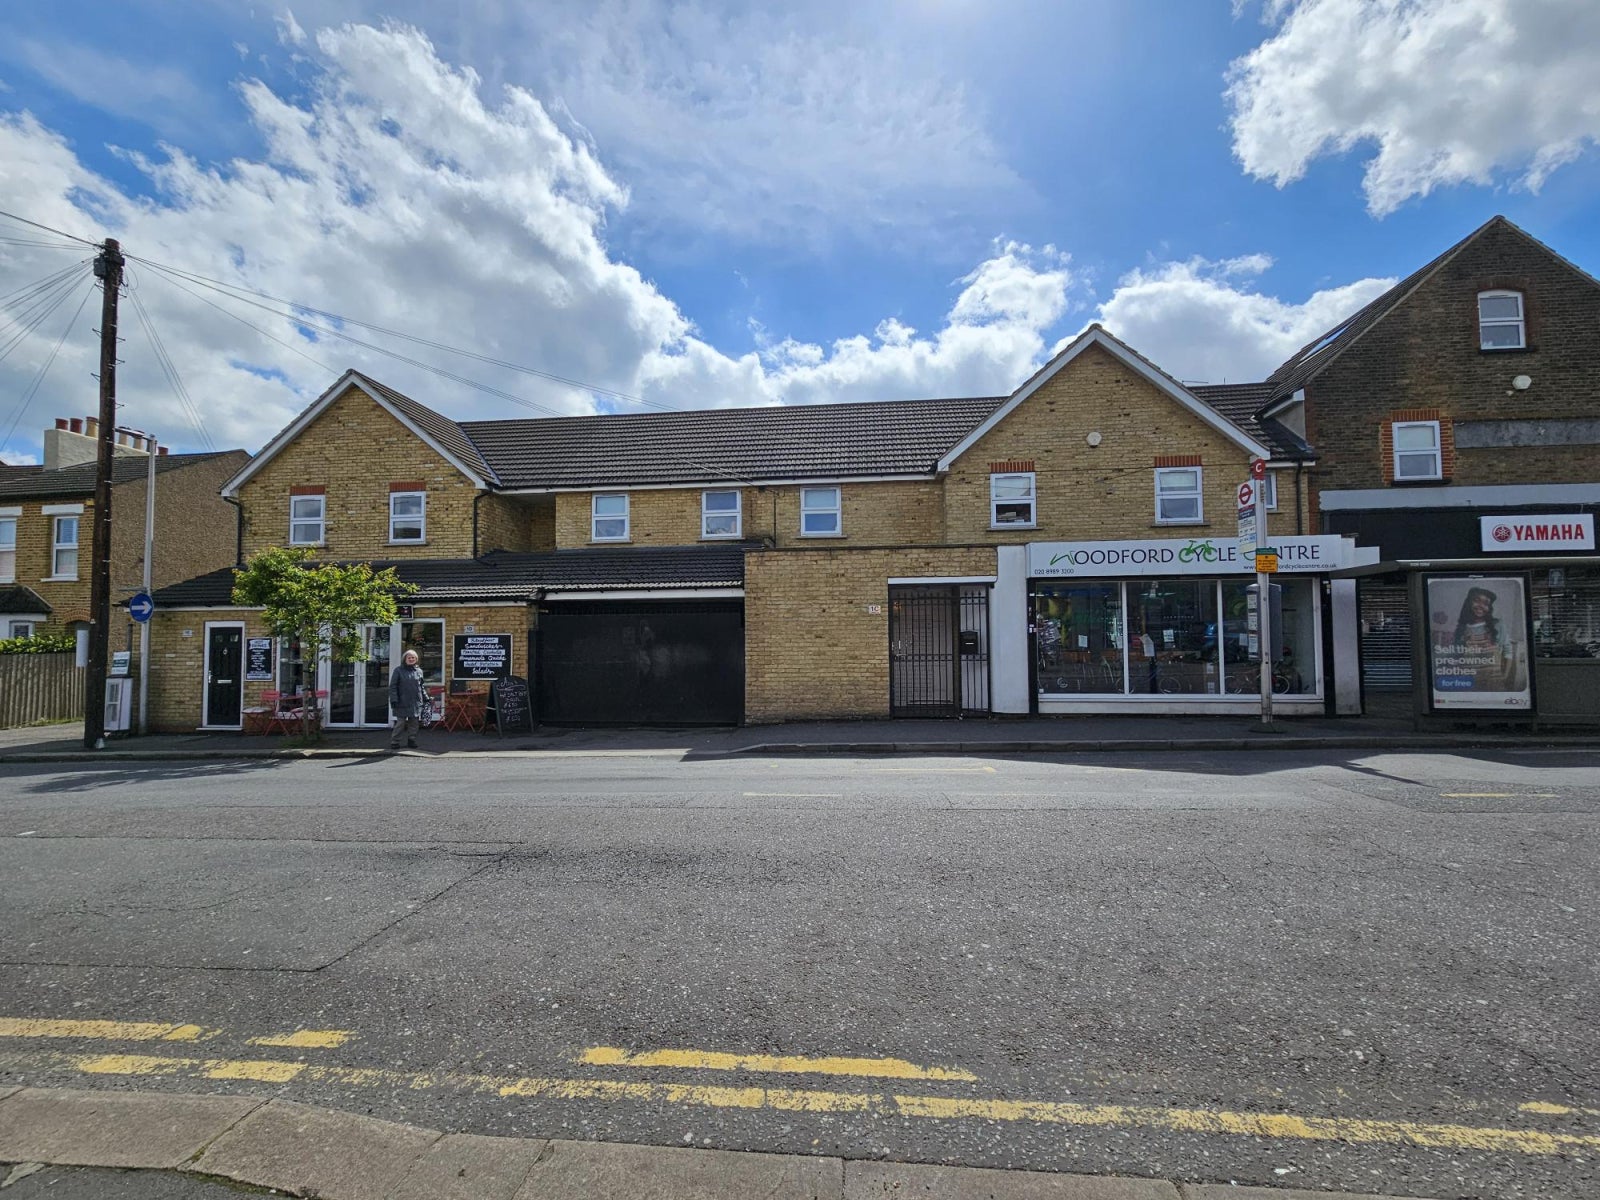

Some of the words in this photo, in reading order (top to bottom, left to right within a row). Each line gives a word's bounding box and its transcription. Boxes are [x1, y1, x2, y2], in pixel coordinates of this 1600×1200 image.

[1255, 463, 1262, 472] C
[1513, 524, 1585, 541] YAMAHA
[1178, 543, 1237, 563] CYCLE
[1434, 645, 1455, 654] Sell
[1456, 645, 1482, 654] their
[1435, 656, 1496, 666] pre-owned
[1435, 667, 1477, 675] clothes
[1504, 697, 1528, 707] ebay
